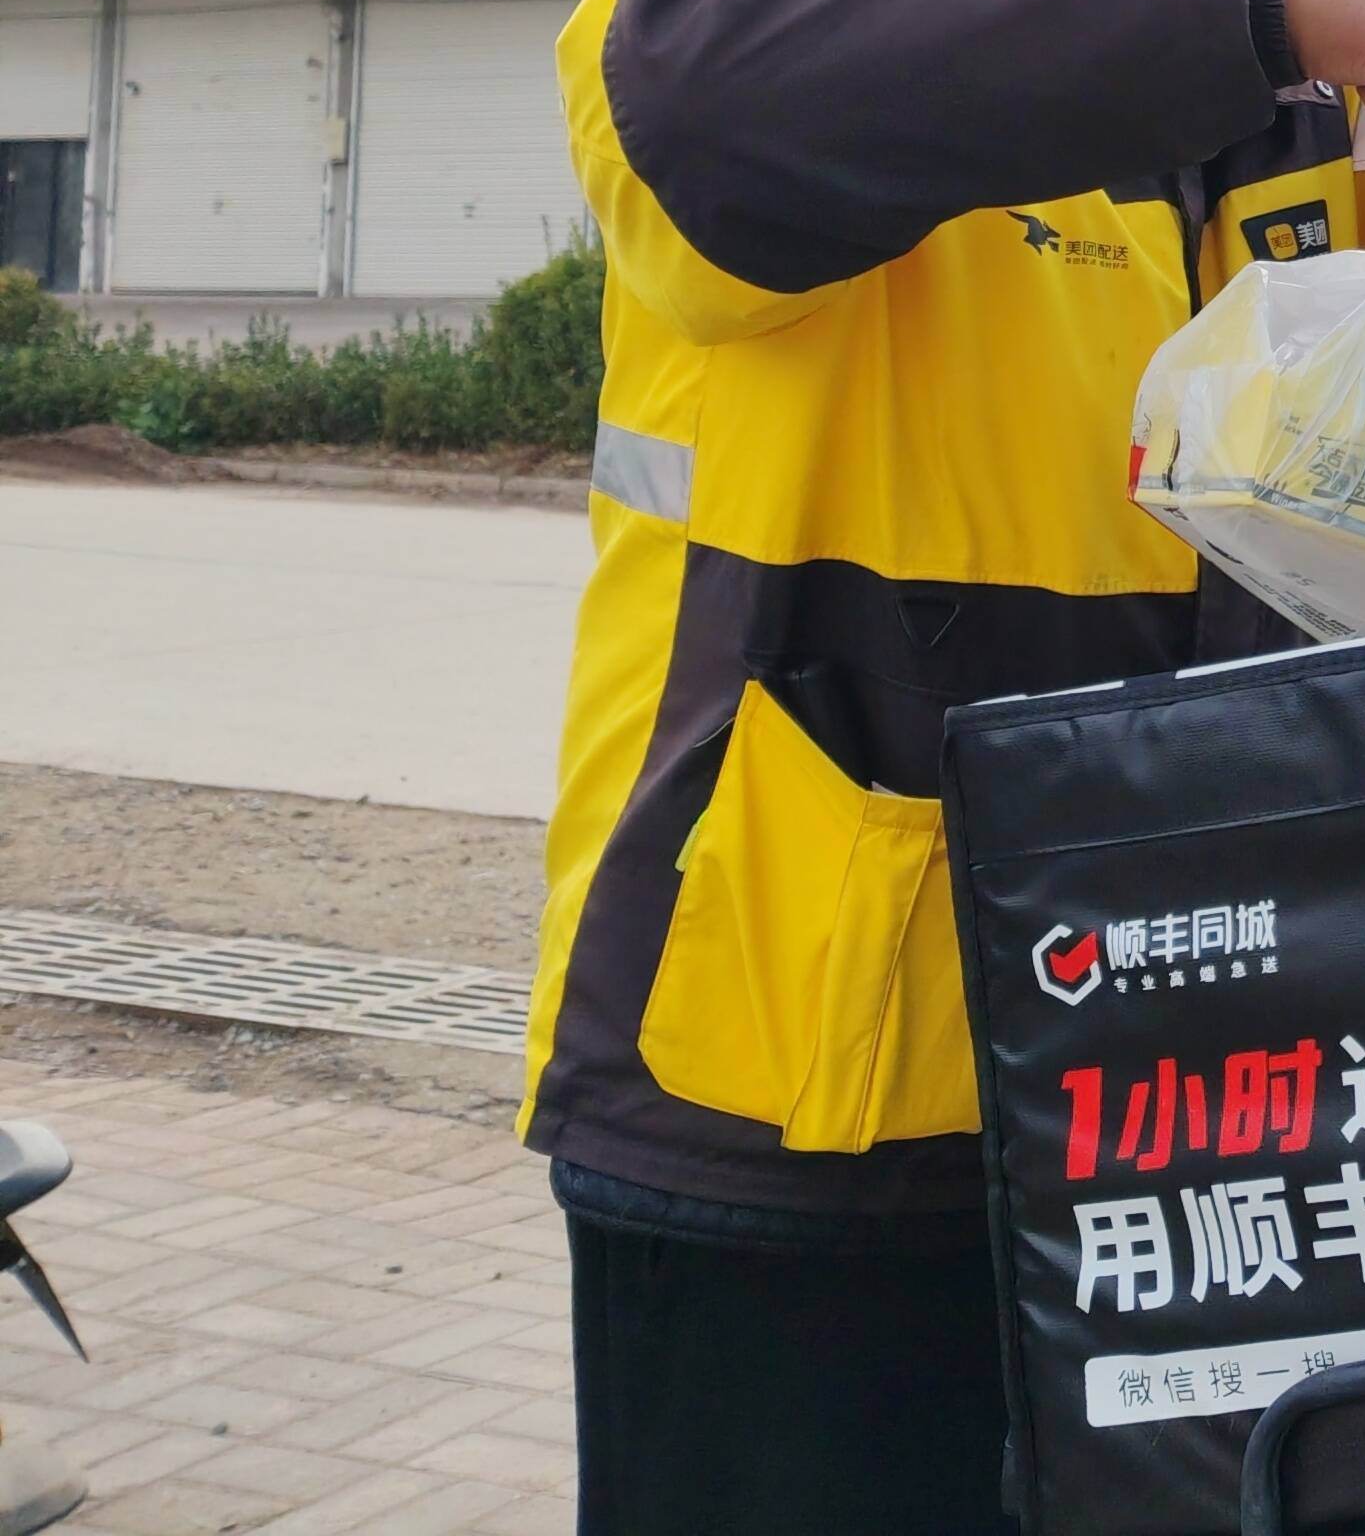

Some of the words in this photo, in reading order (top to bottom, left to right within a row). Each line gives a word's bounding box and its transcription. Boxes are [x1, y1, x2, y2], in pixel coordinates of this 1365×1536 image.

[1064, 240, 1129, 262] 美团配送
[1295, 218, 1328, 250] 美团
[1105, 899, 1277, 971] 顺丰同城
[1113, 955, 1279, 994] 专业高端急送
[1117, 1350, 1336, 1409] 微信搜一搜
